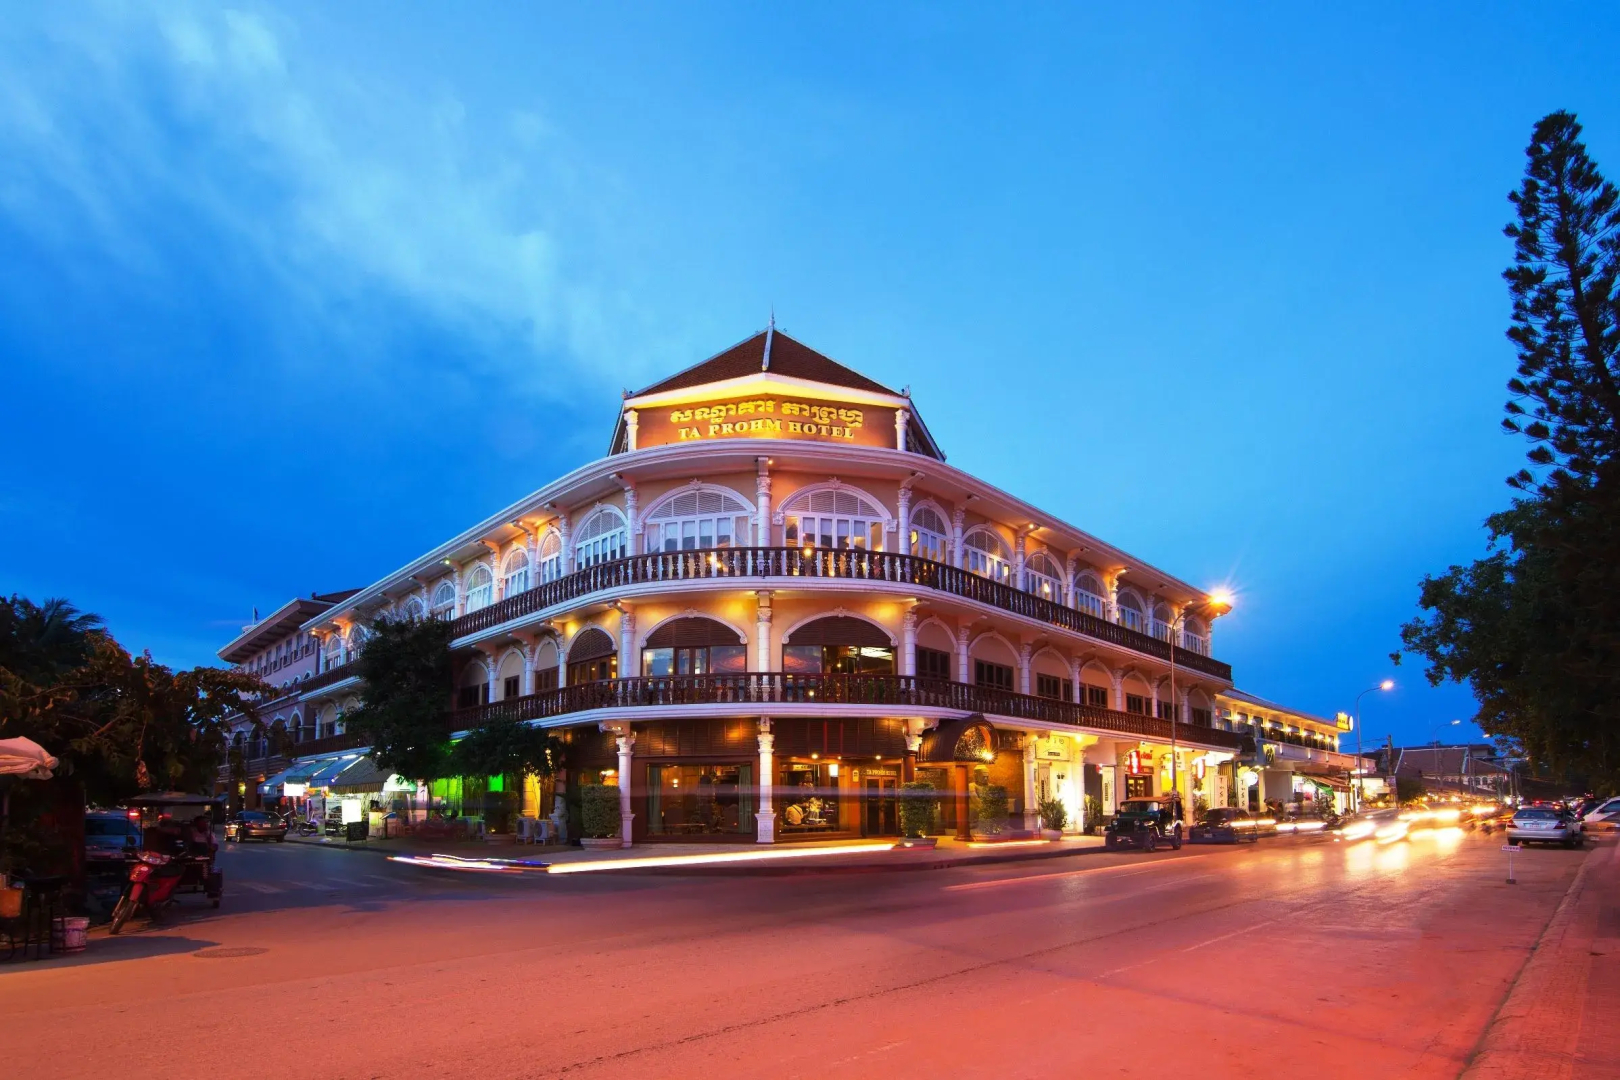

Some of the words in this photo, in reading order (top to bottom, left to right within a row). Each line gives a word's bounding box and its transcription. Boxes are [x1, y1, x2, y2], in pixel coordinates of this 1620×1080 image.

[678, 427, 702, 440] TA
[708, 418, 783, 437] PROHM
[788, 420, 854, 439] HOTEL
